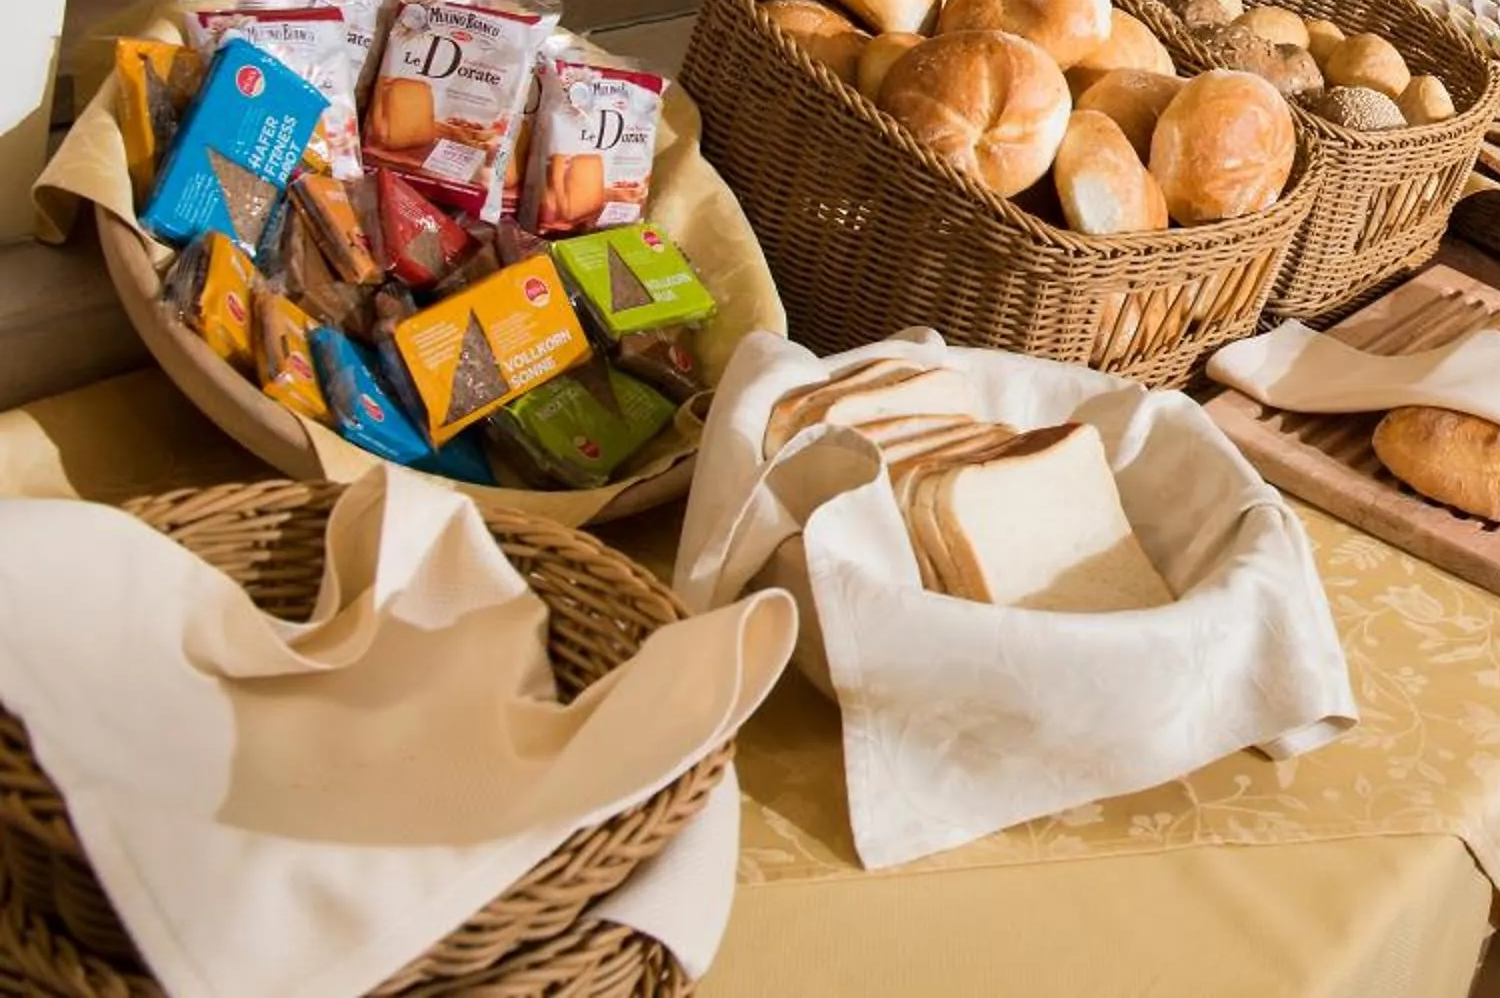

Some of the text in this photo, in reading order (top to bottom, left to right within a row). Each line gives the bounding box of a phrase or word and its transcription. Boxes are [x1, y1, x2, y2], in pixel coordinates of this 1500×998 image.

[416, 34, 501, 86] Dorate
[248, 115, 279, 170] HAFER
[504, 329, 572, 372] VOLLKORN
